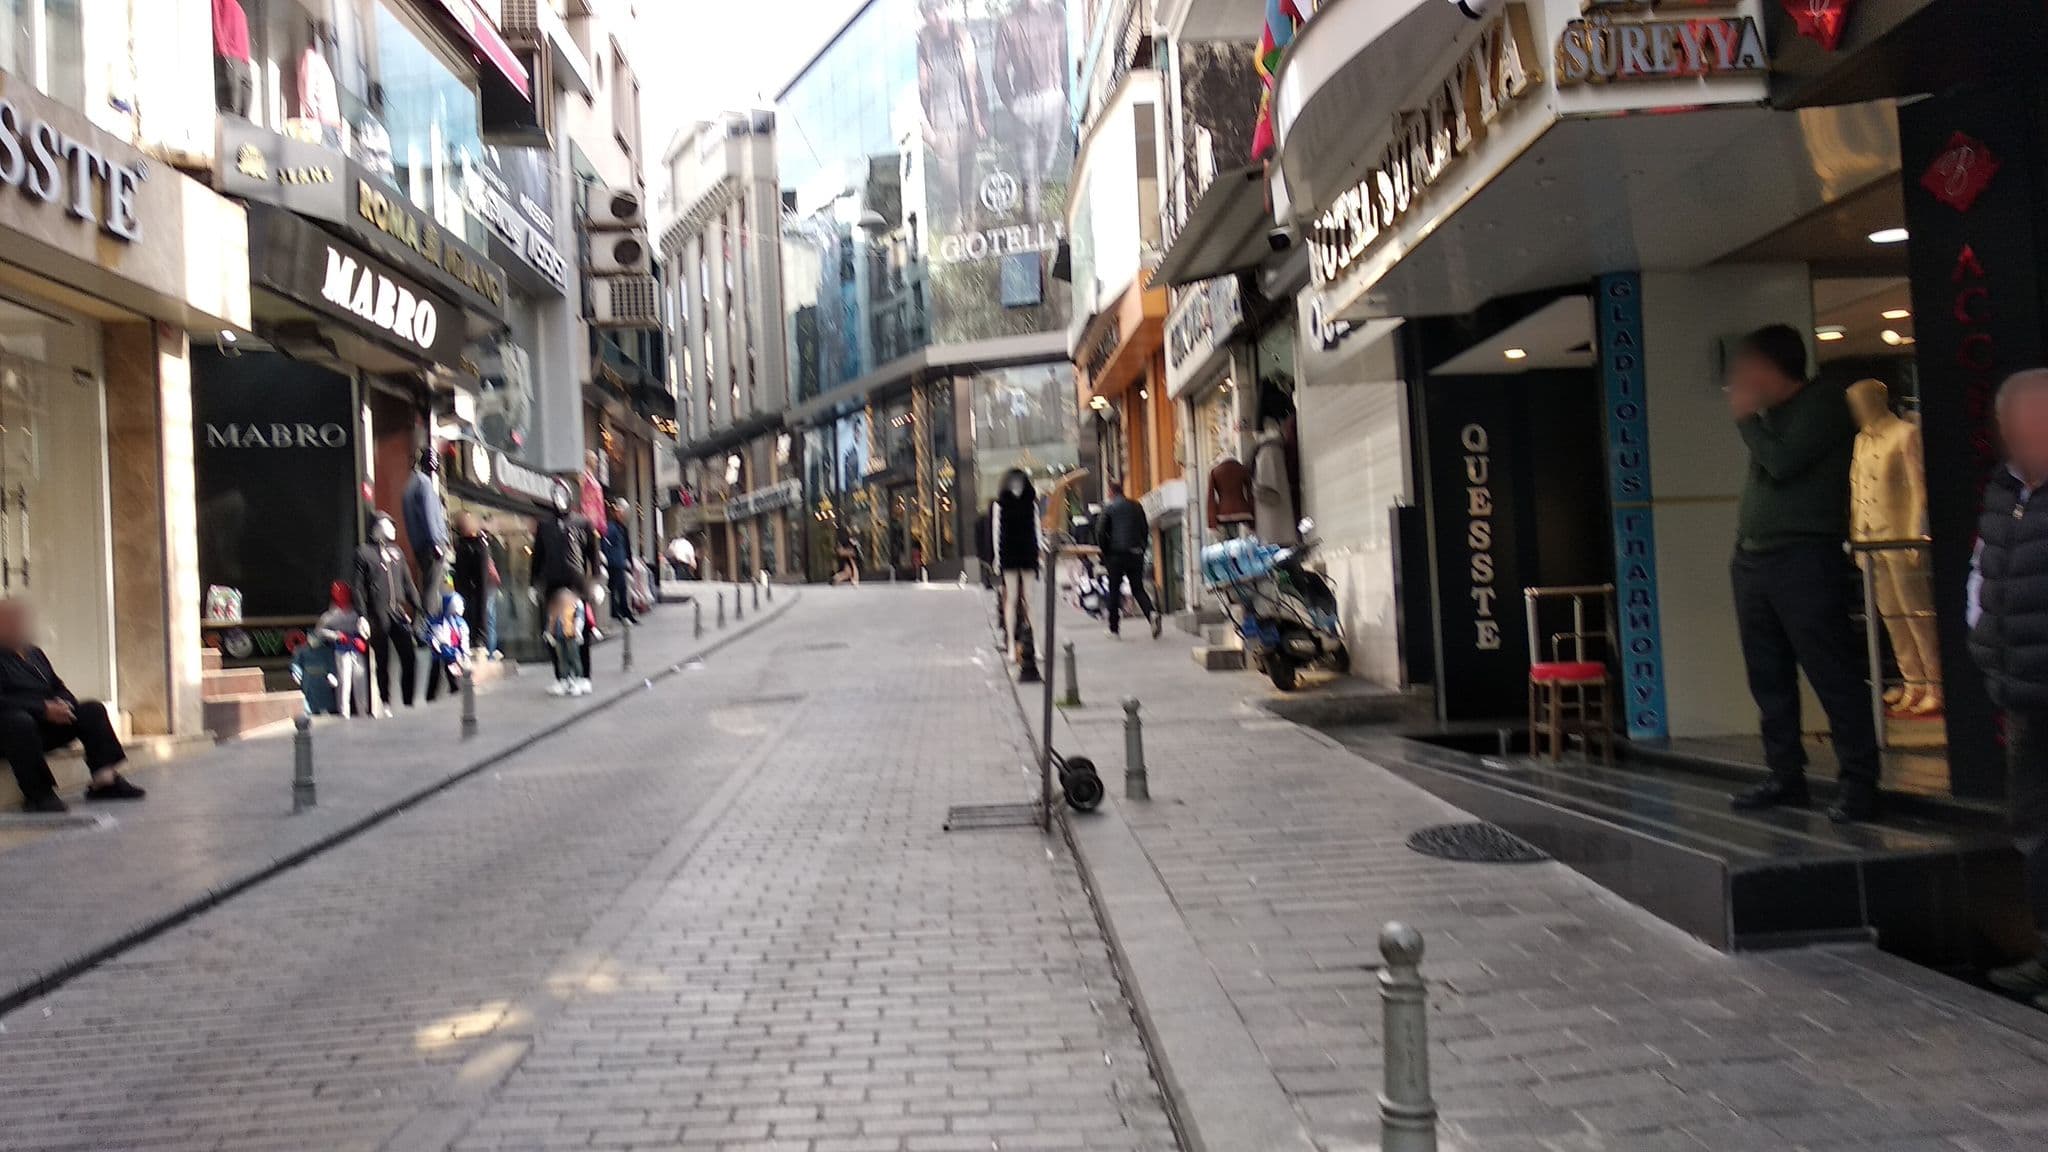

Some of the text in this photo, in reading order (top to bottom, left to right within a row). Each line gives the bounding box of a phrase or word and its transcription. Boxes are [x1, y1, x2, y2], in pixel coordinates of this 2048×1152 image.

[321, 244, 438, 350] MABRO
[205, 421, 348, 449] MABRO
[1608, 277, 1642, 496] GLADIOLUS
[1460, 422, 1503, 651] QUESSTE
